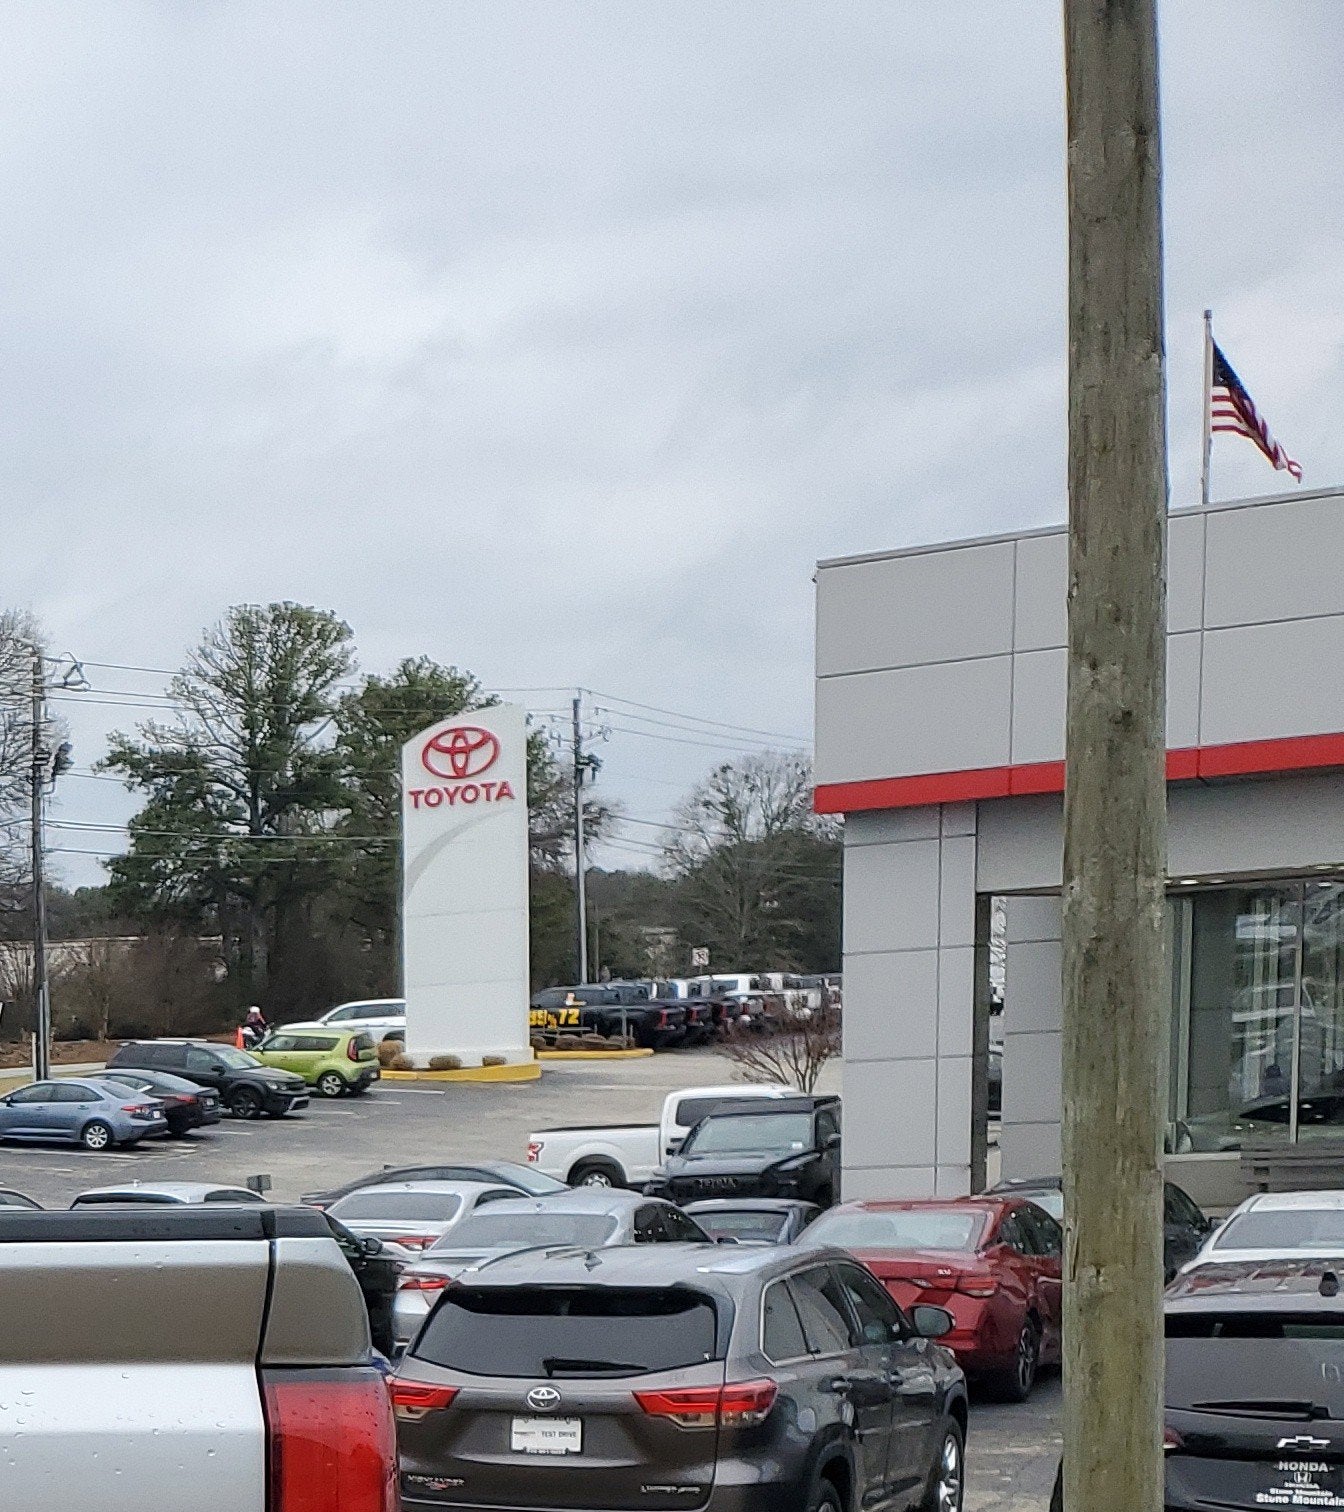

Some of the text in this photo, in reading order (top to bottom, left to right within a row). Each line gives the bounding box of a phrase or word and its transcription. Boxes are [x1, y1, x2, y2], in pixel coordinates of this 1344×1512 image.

[408, 780, 515, 809] TOYOTA
[1278, 1461, 1329, 1473] HONDA
[1256, 1492, 1290, 1504] Stone
